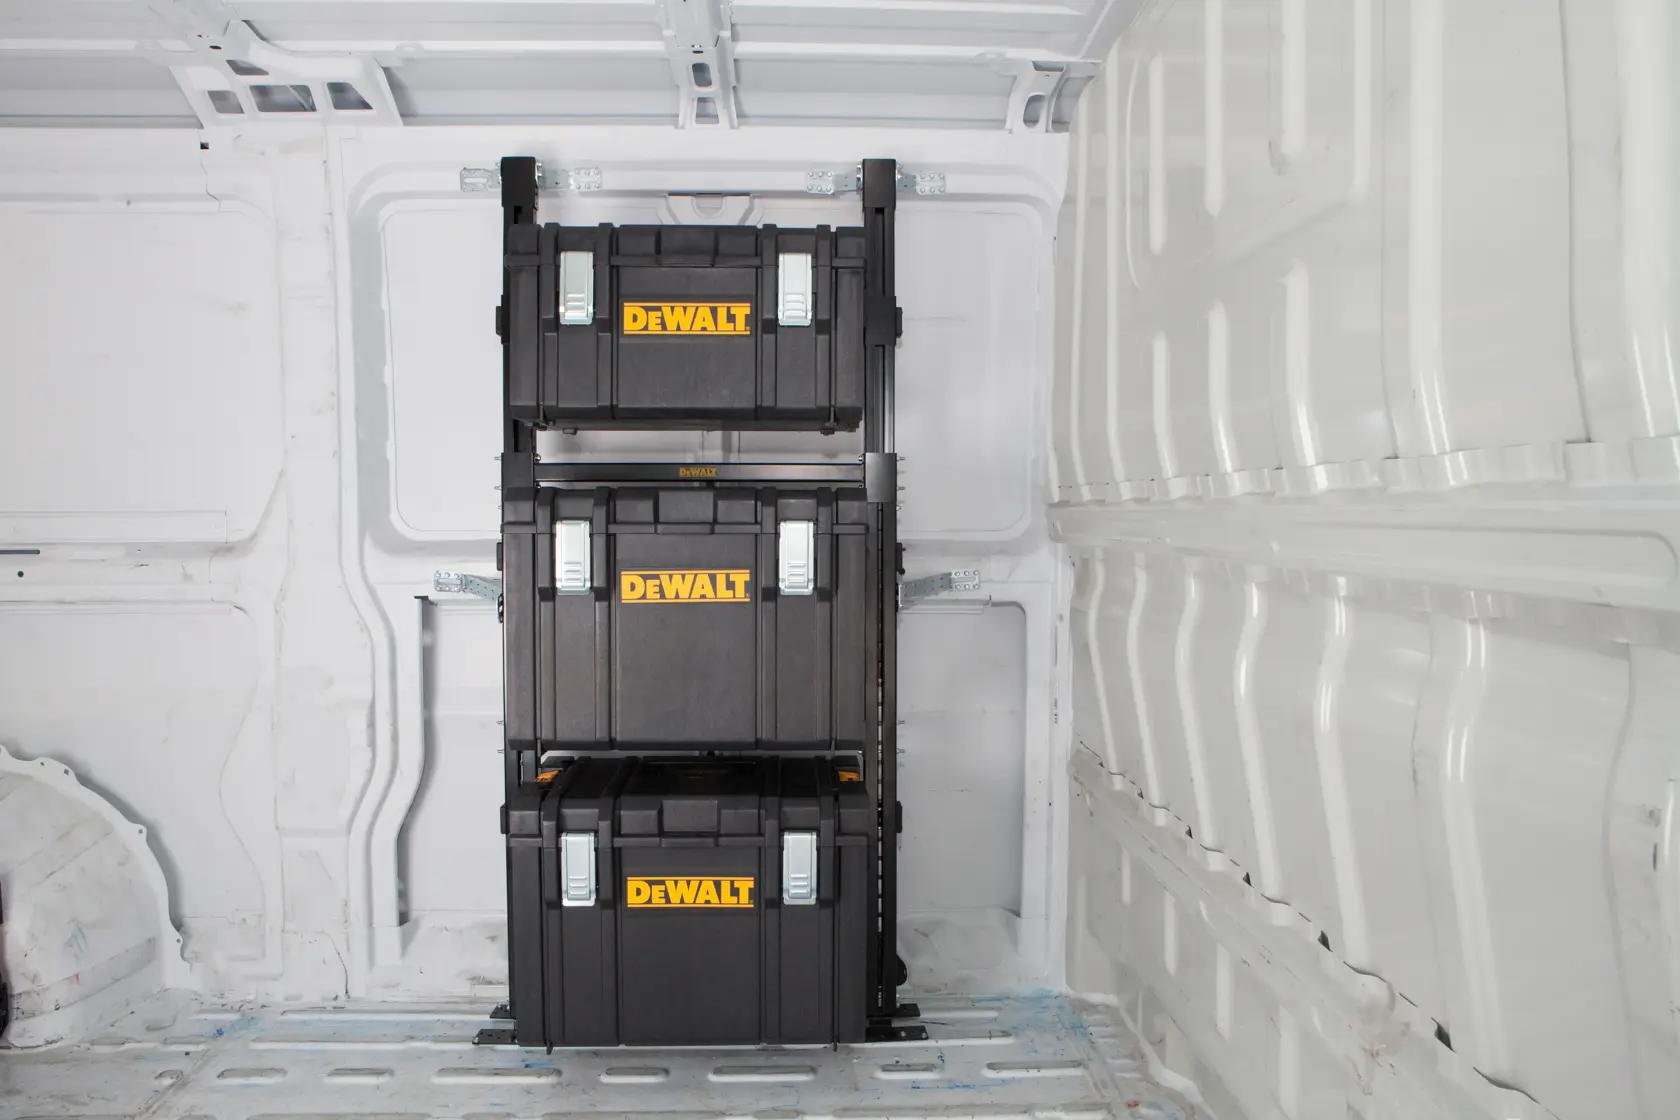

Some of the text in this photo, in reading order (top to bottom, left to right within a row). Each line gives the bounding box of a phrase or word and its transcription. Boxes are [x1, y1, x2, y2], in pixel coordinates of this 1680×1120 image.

[623, 306, 751, 332] DEWALT
[622, 573, 750, 600] DEWALT
[627, 880, 754, 905] DEWALT
